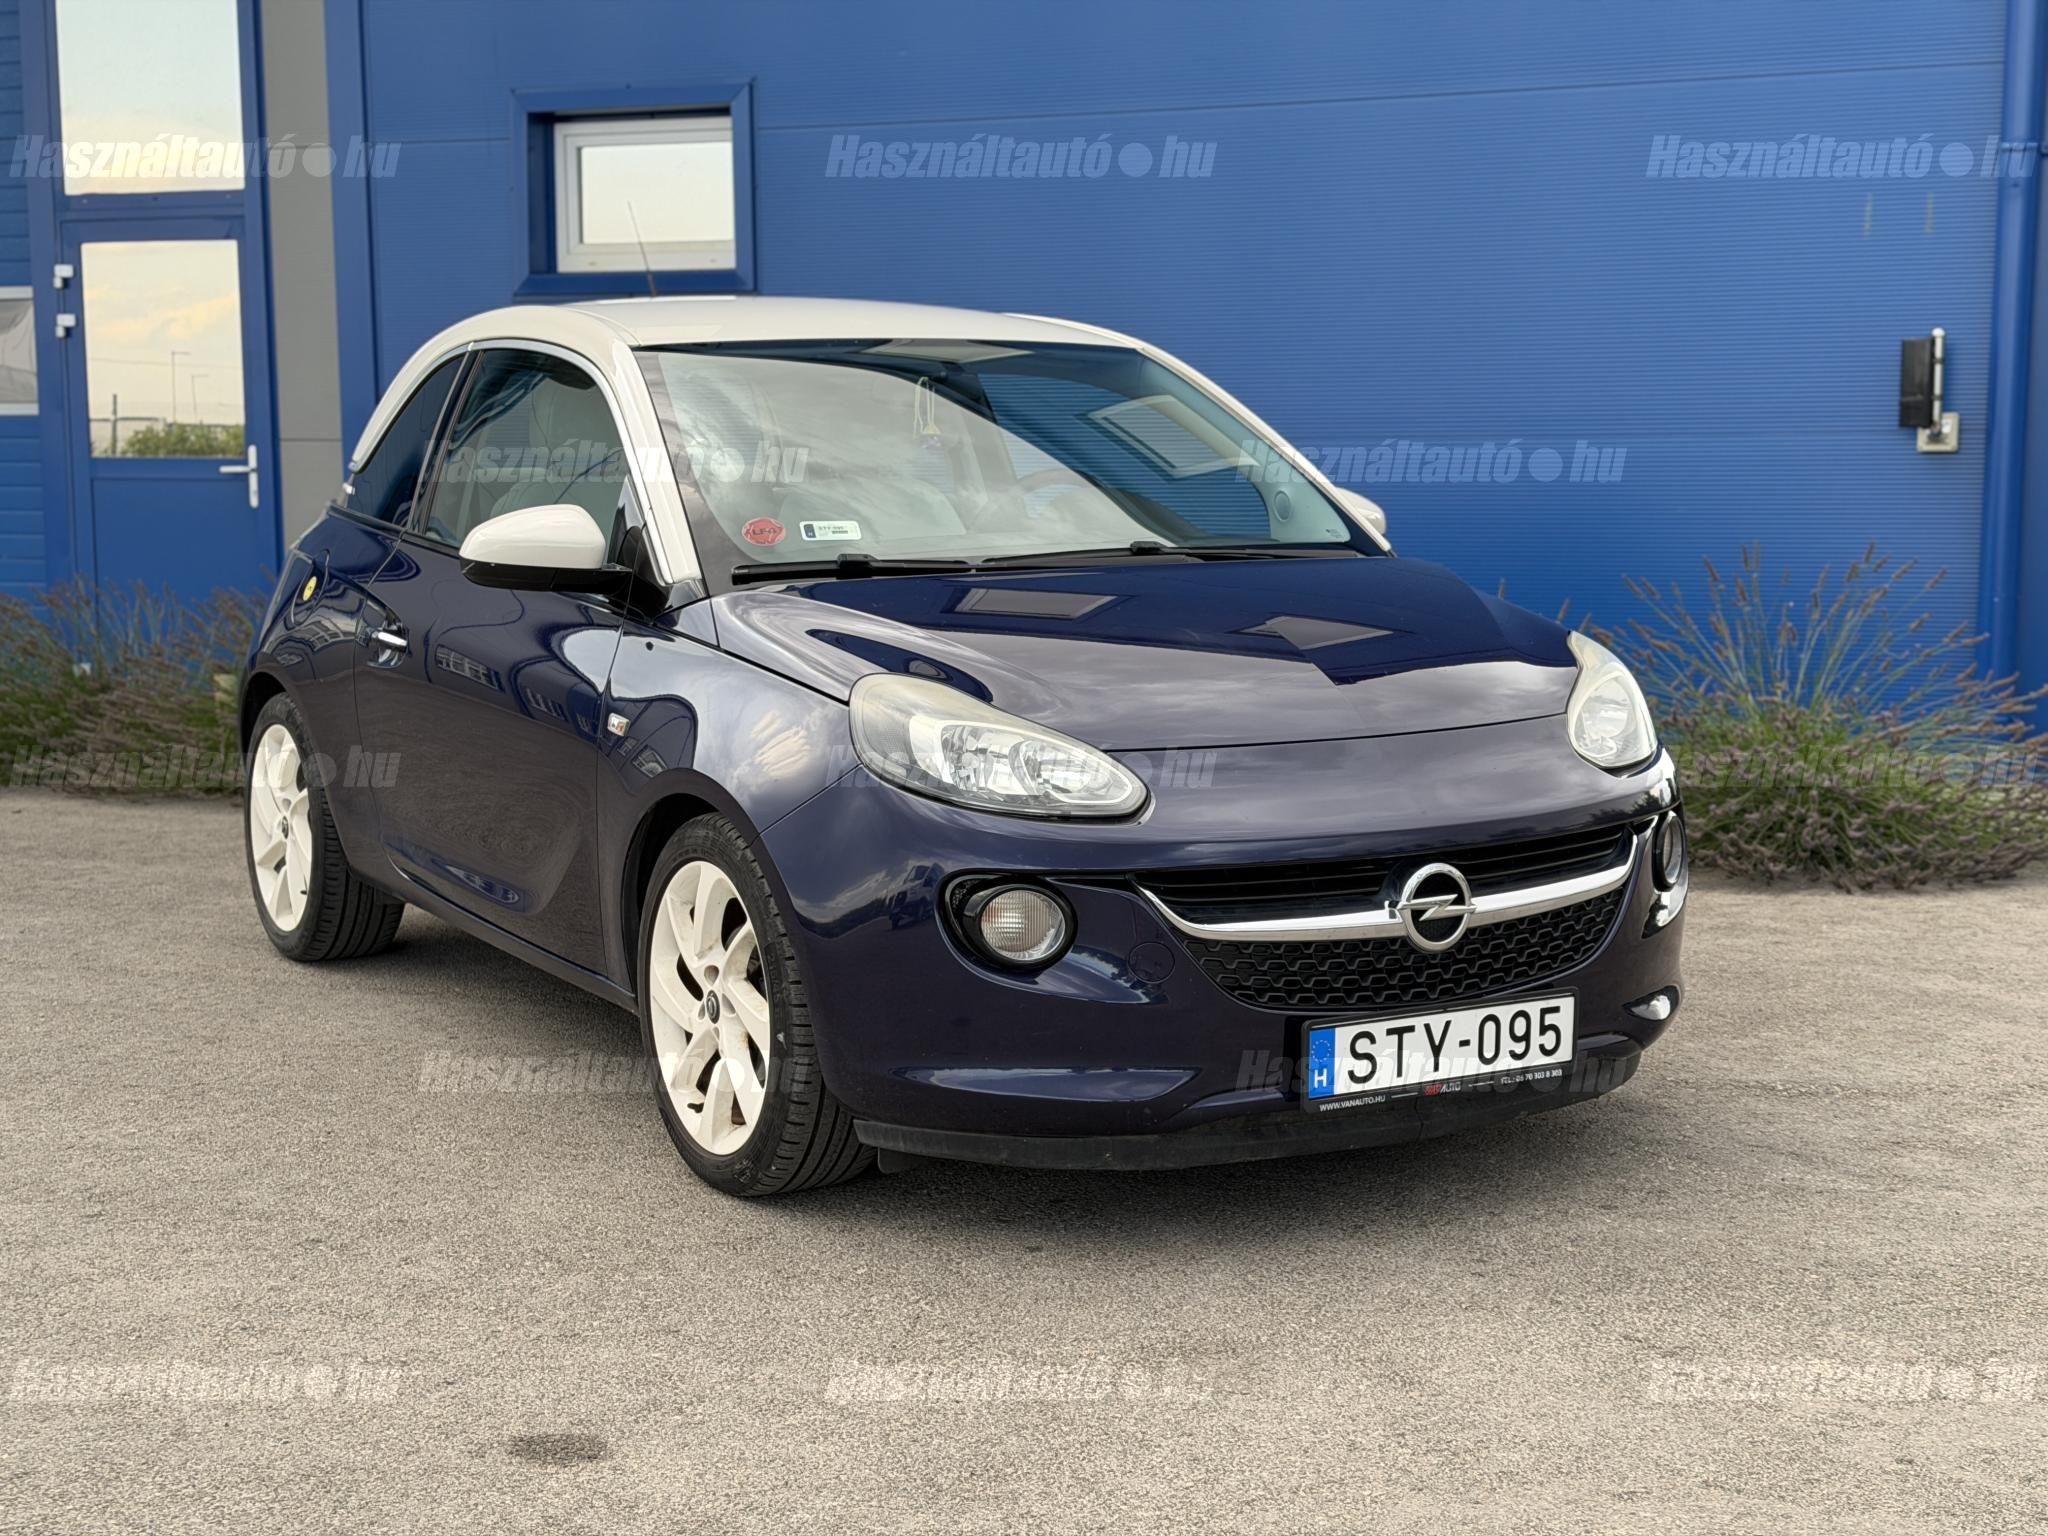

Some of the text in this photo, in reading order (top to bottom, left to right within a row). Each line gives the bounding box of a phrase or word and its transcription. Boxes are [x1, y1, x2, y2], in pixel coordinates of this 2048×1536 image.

[1347, 1005, 1562, 1085] STY-095
[1313, 1068, 1328, 1088] H
[1319, 1094, 1387, 1112] WWW.VANAUTO.HU
